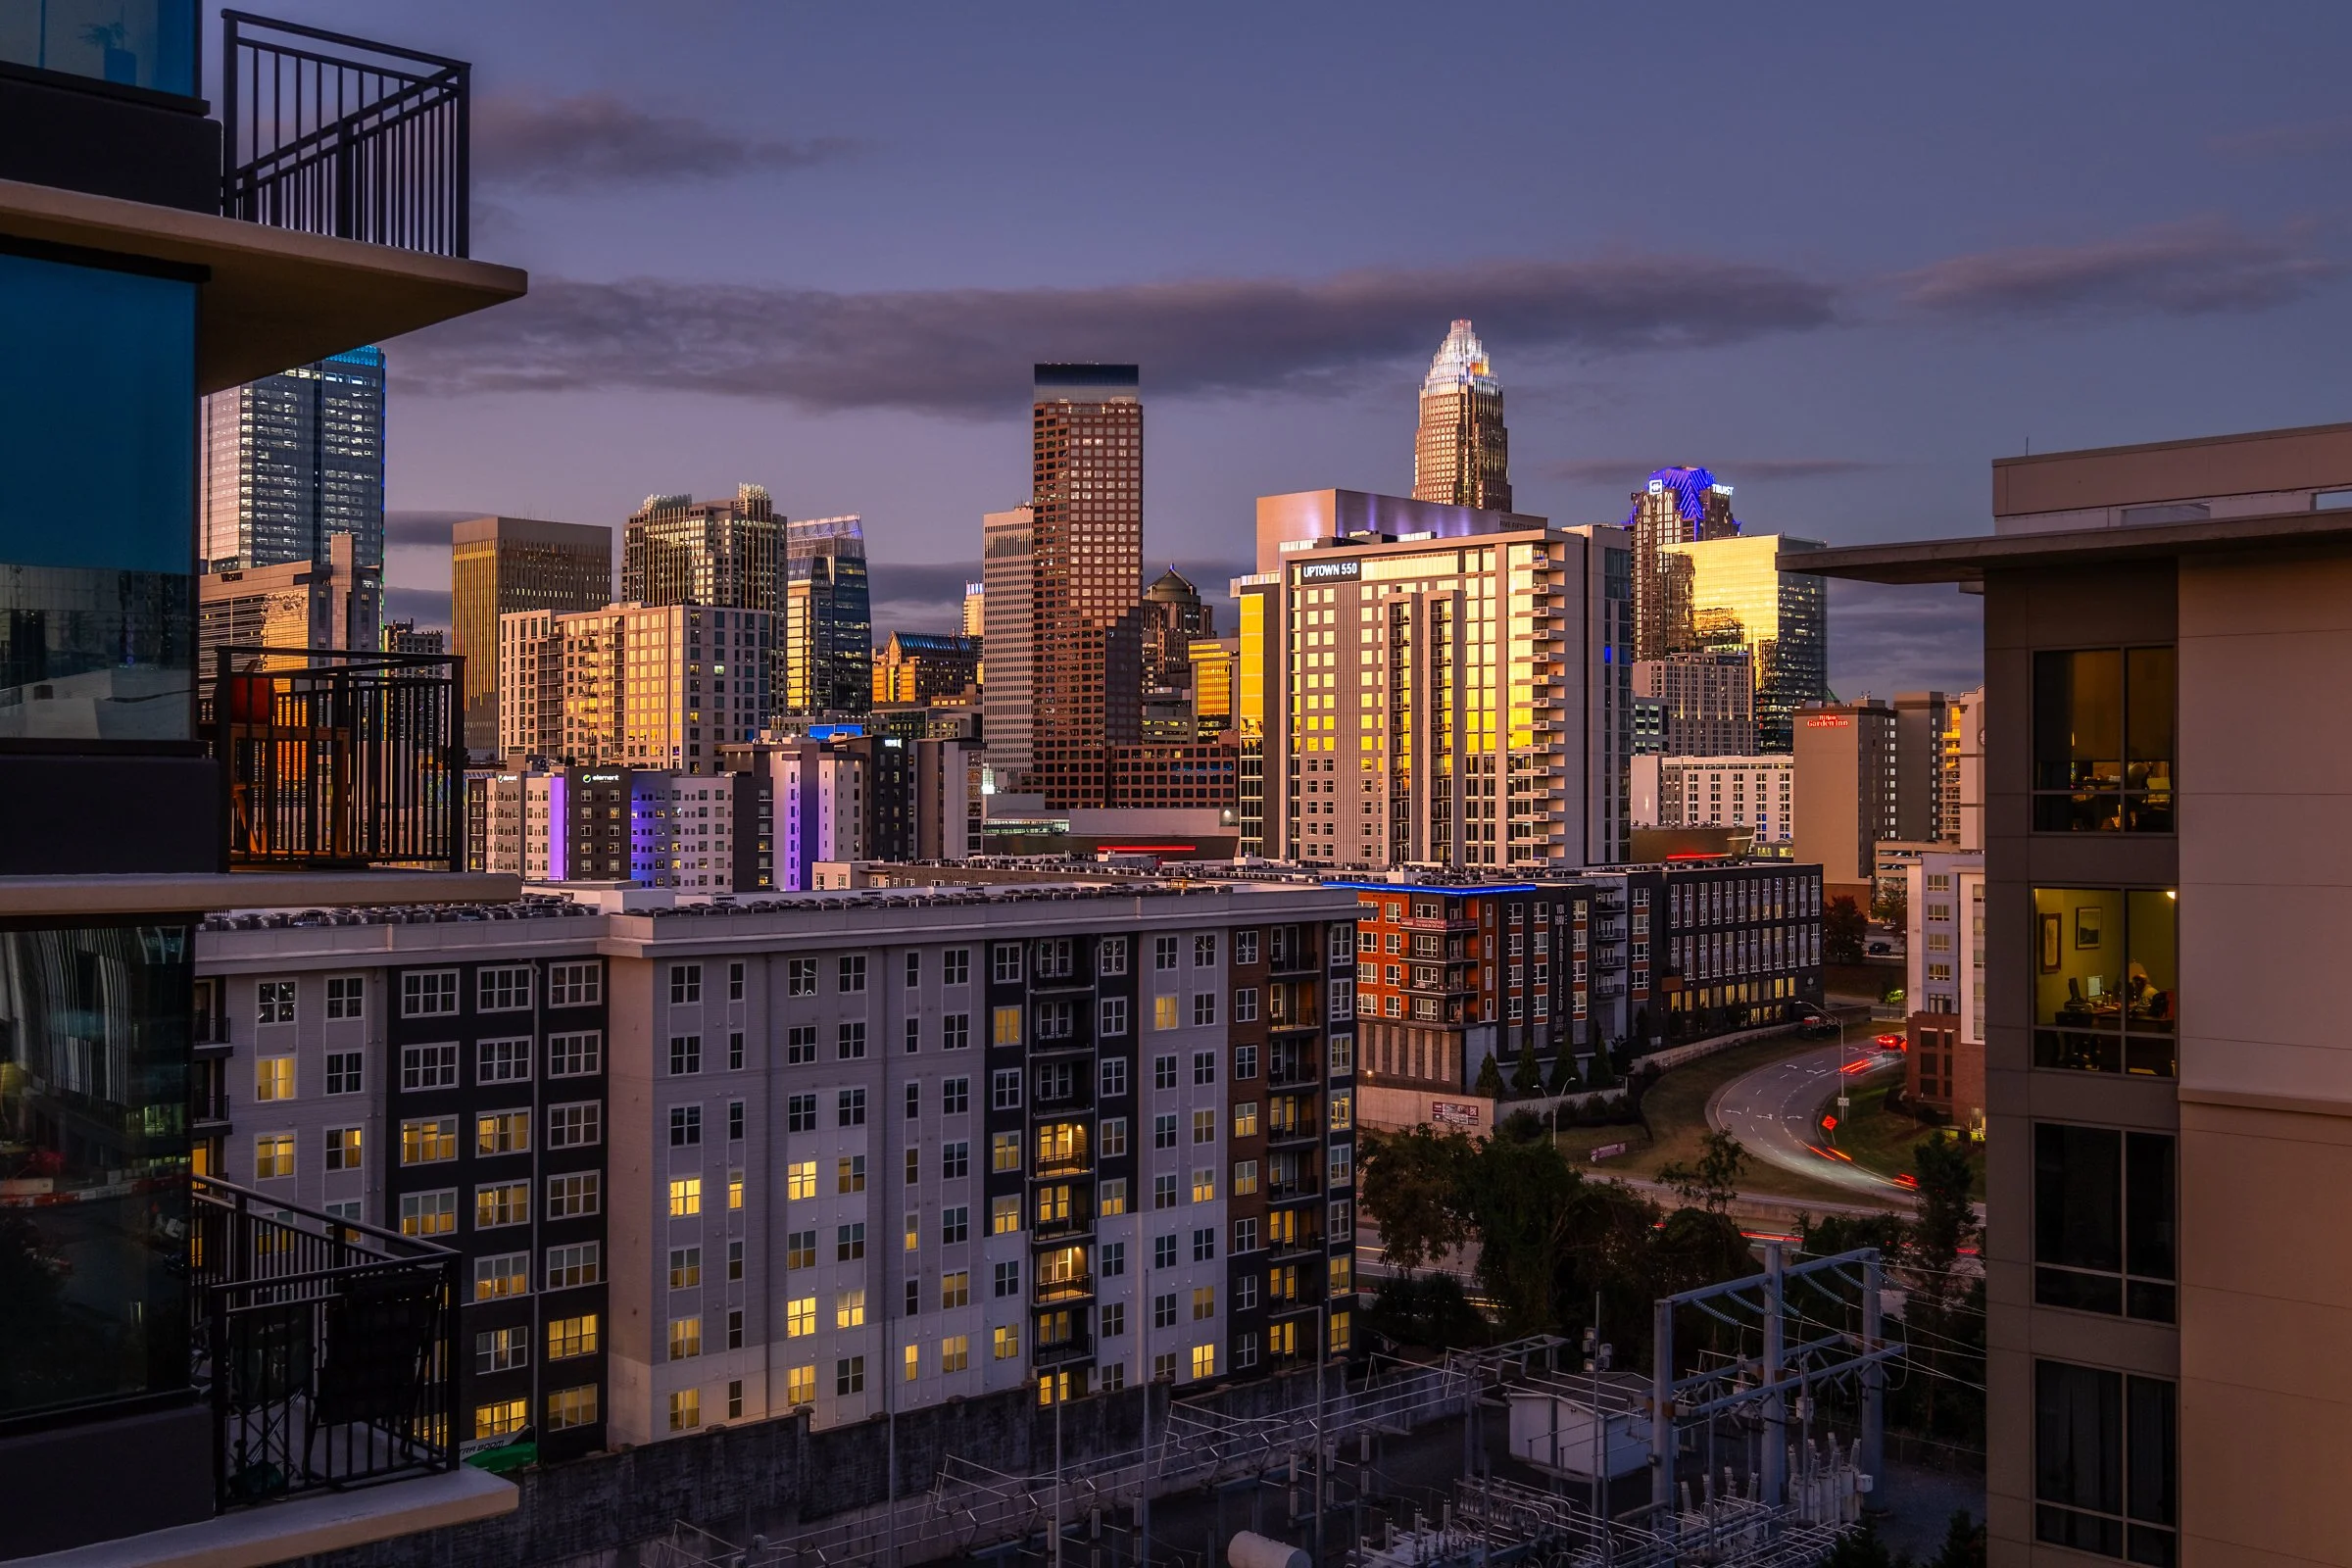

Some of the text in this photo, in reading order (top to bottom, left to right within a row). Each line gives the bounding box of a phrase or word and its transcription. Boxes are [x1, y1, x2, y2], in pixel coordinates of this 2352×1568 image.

[1711, 483, 1735, 496] TRUIST
[1303, 563, 1357, 577] UPTOWN 550
[1556, 904, 1565, 914] YOU
[477, 1440, 505, 1451] BOOM
